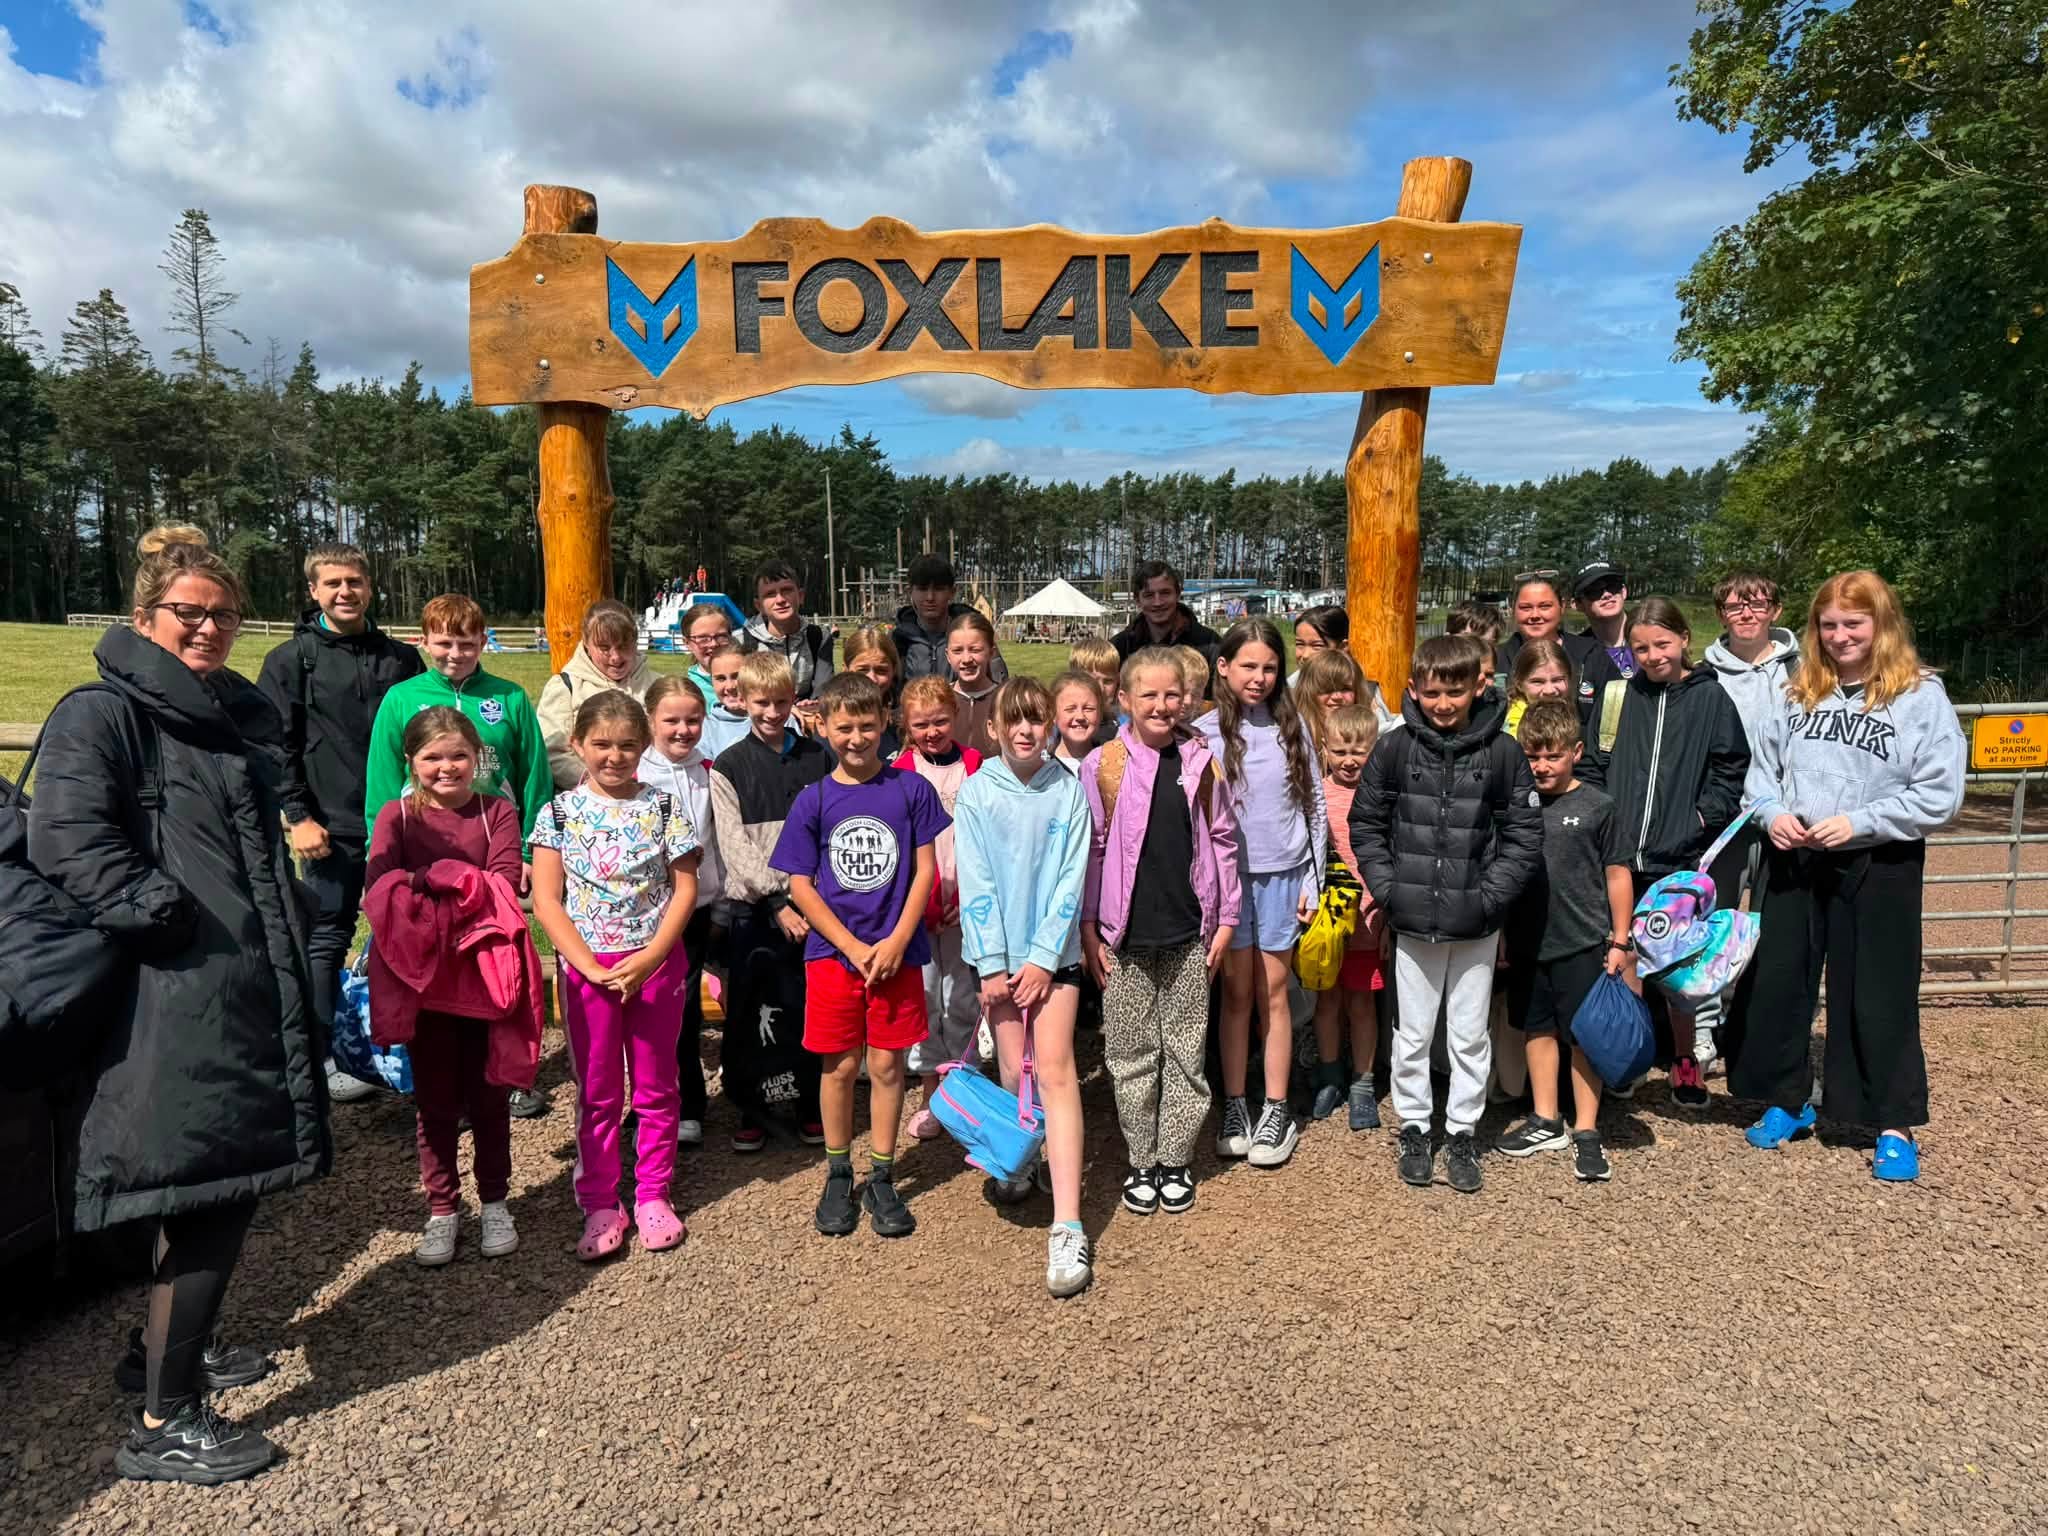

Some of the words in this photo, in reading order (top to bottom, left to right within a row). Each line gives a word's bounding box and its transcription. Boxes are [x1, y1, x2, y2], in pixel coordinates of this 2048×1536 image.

[732, 251, 1259, 354] FOXLAKE
[1787, 708, 1895, 761] PINK
[2000, 737, 2031, 745] Strictly
[1984, 746, 1999, 754] NO
[2002, 745, 2042, 754] PARKING
[841, 849, 874, 864] fun
[848, 864, 881, 876] run
